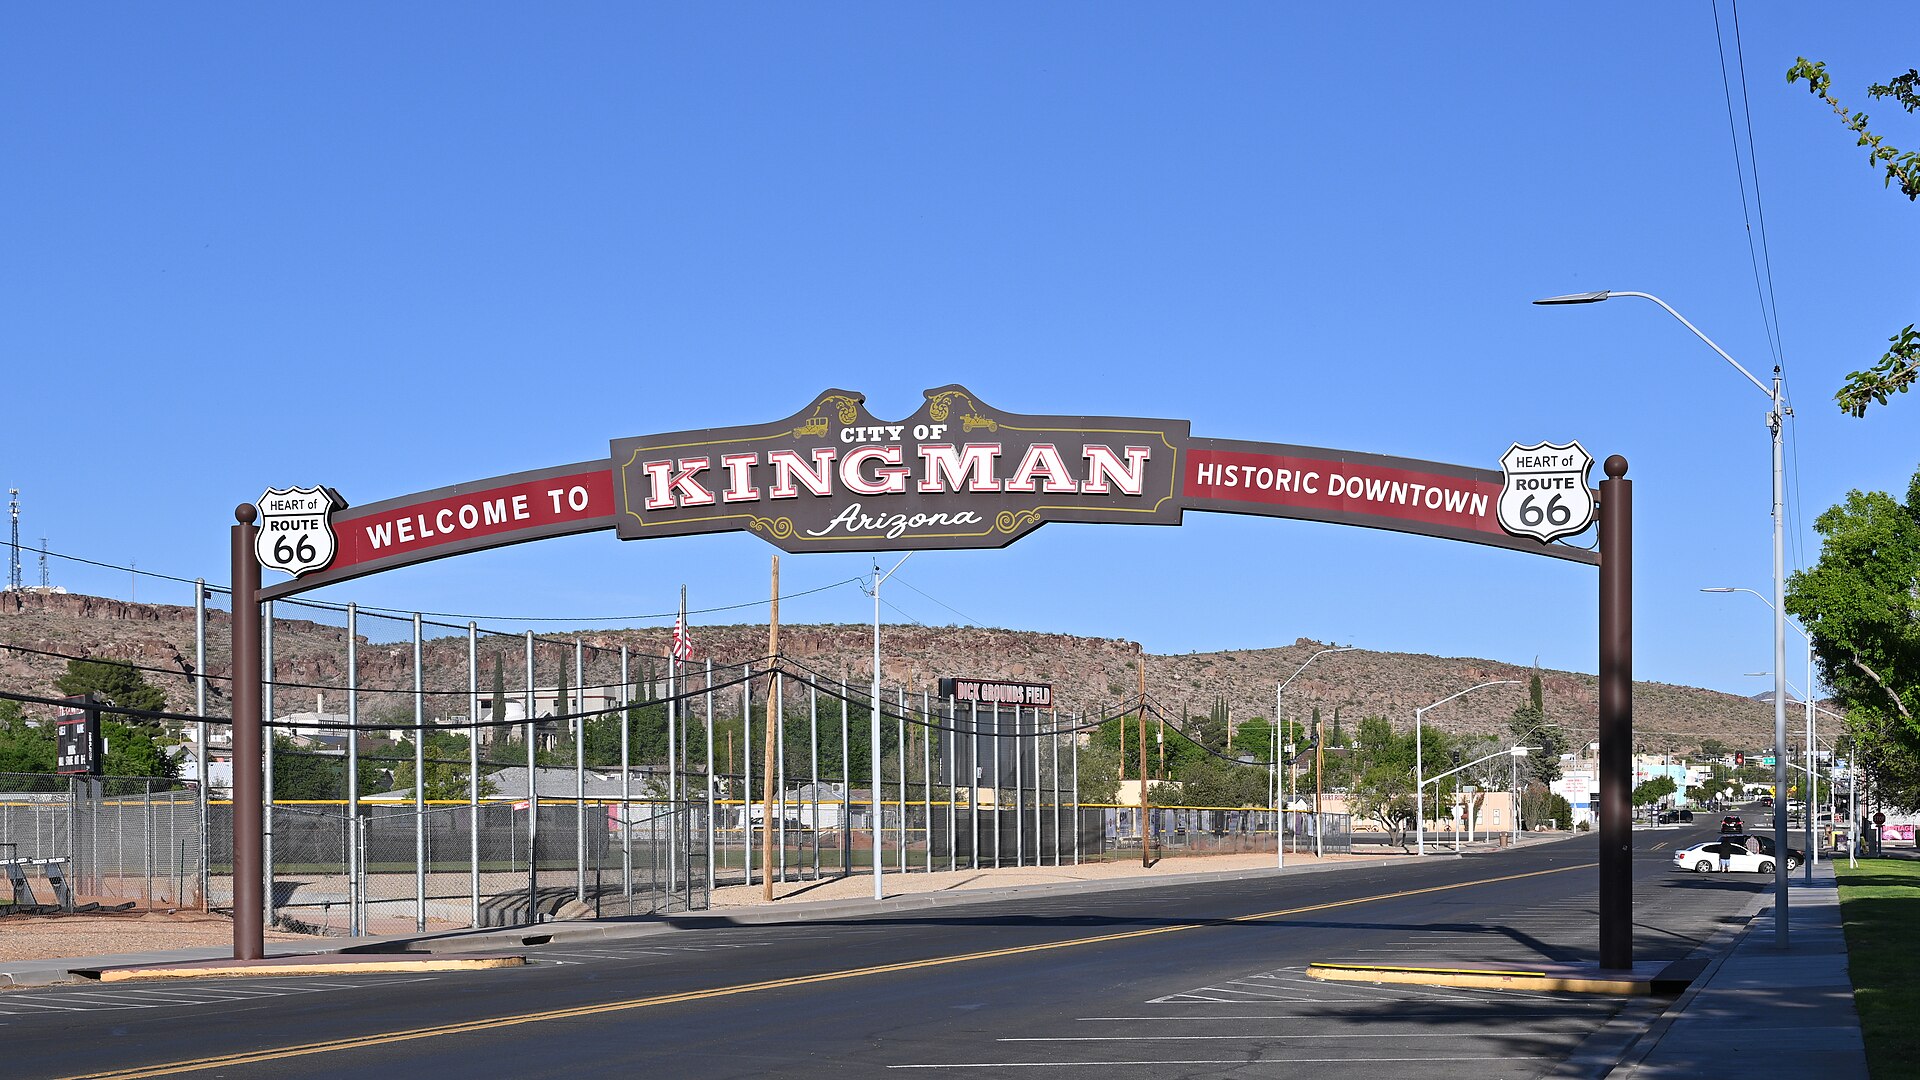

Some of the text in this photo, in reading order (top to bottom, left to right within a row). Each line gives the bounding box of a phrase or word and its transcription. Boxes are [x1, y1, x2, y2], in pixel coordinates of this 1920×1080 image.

[840, 423, 948, 444] CITY OF
[1516, 454, 1574, 468] HEART of
[643, 442, 1150, 512] KINGMAN
[1197, 463, 1488, 517] HISTORIC DOWNTOWN
[1516, 477, 1575, 490] ROUTE
[270, 498, 318, 511] HEART of
[366, 485, 589, 549] WELCOME TO
[1519, 493, 1571, 527] 66
[270, 519, 319, 532] ROUTE
[806, 502, 982, 539] Arizona
[273, 533, 316, 564] 66
[957, 682, 1050, 705] DICK GROUNDS FIELD
